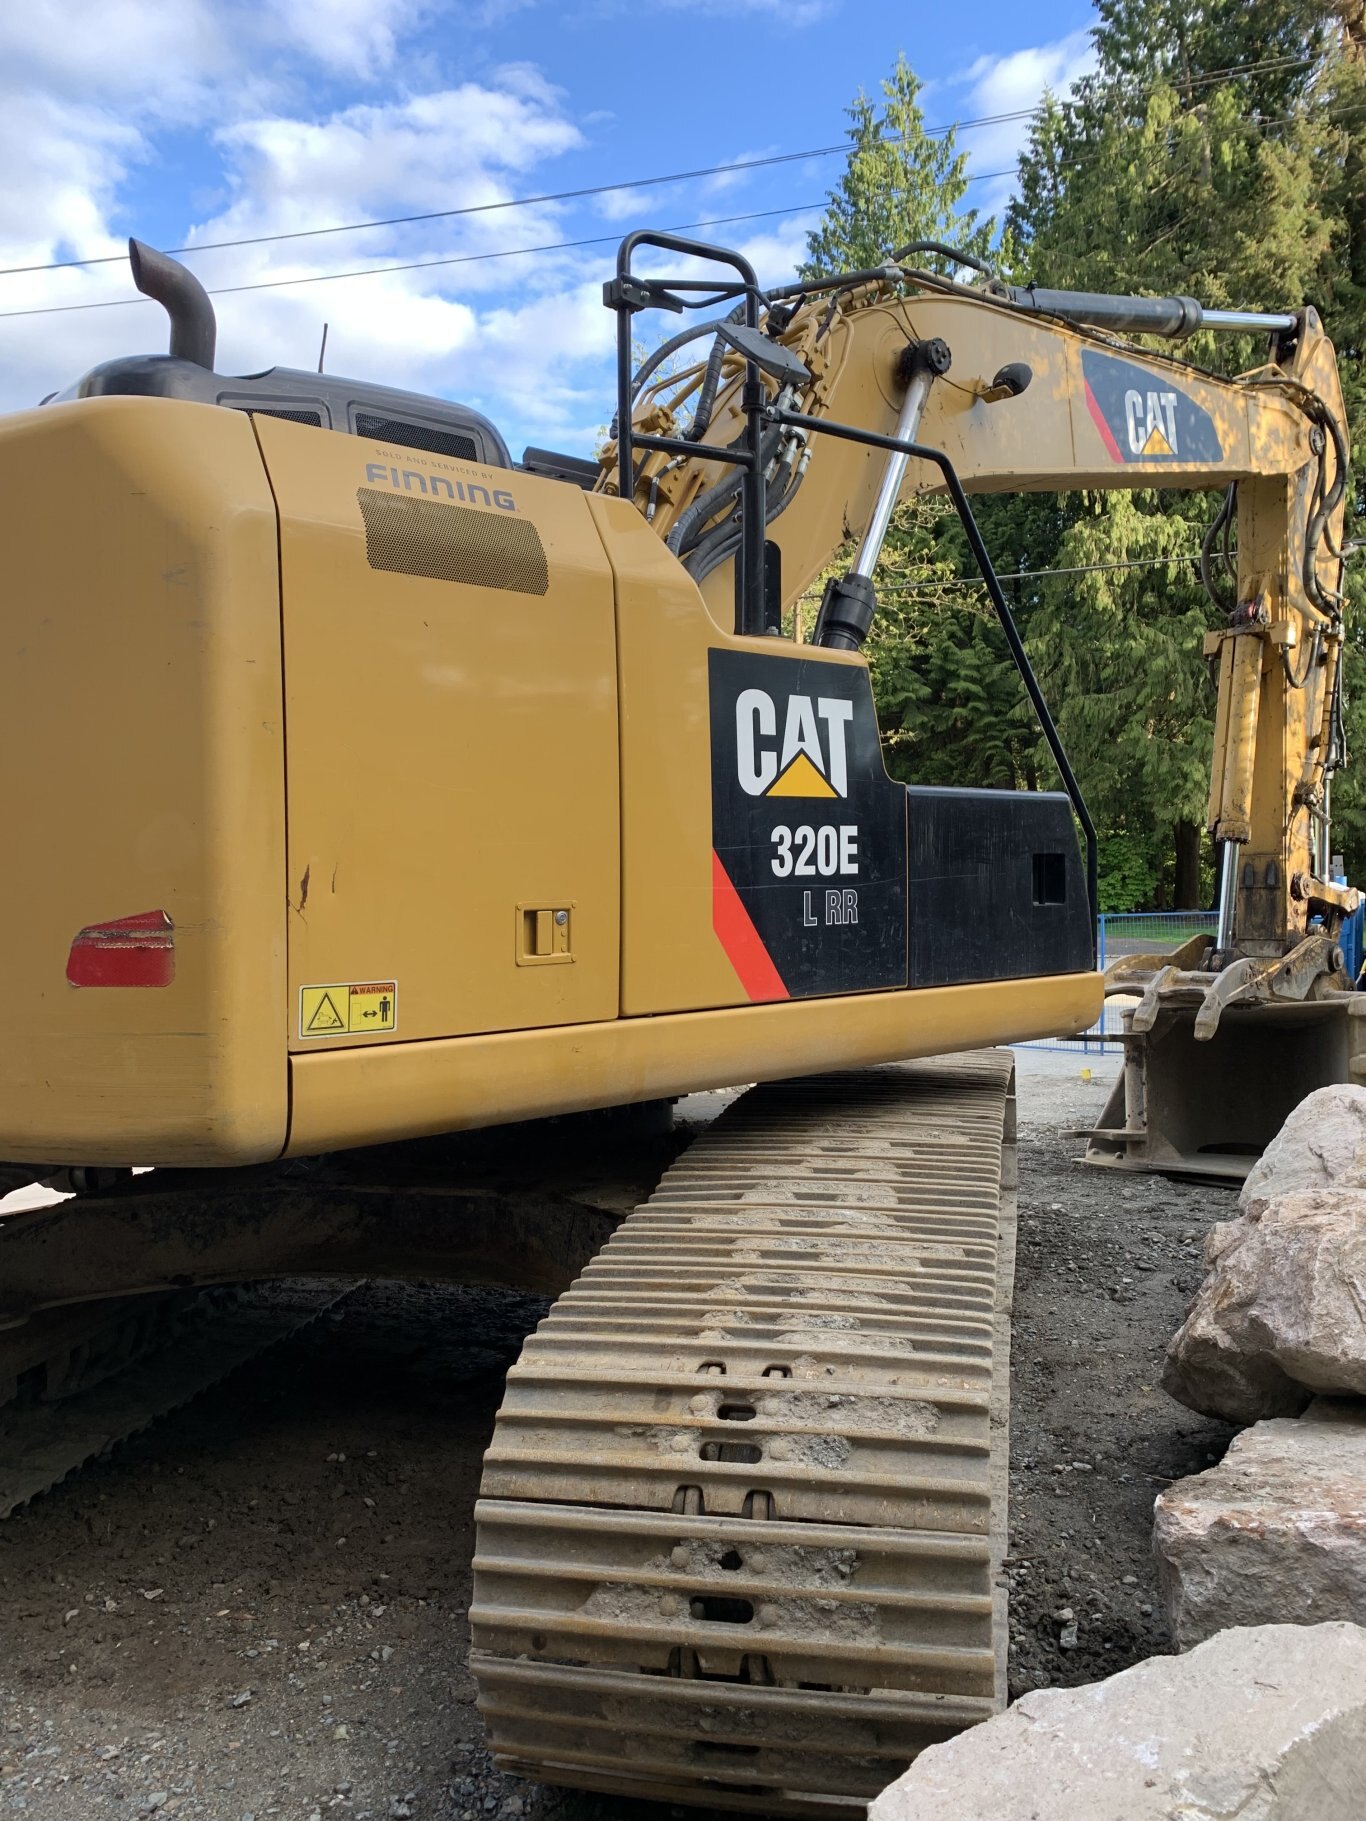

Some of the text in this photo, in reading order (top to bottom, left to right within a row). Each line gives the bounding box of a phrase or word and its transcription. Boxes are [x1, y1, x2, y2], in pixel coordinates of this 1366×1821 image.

[1124, 389, 1178, 454] CAT
[365, 463, 516, 512] FINNING
[375, 449, 494, 480] SOLD AND SERVICED BY
[736, 688, 853, 798] CAT
[770, 825, 859, 878] 320E
[803, 889, 859, 927] L RR
[359, 985, 394, 995] WARNING
